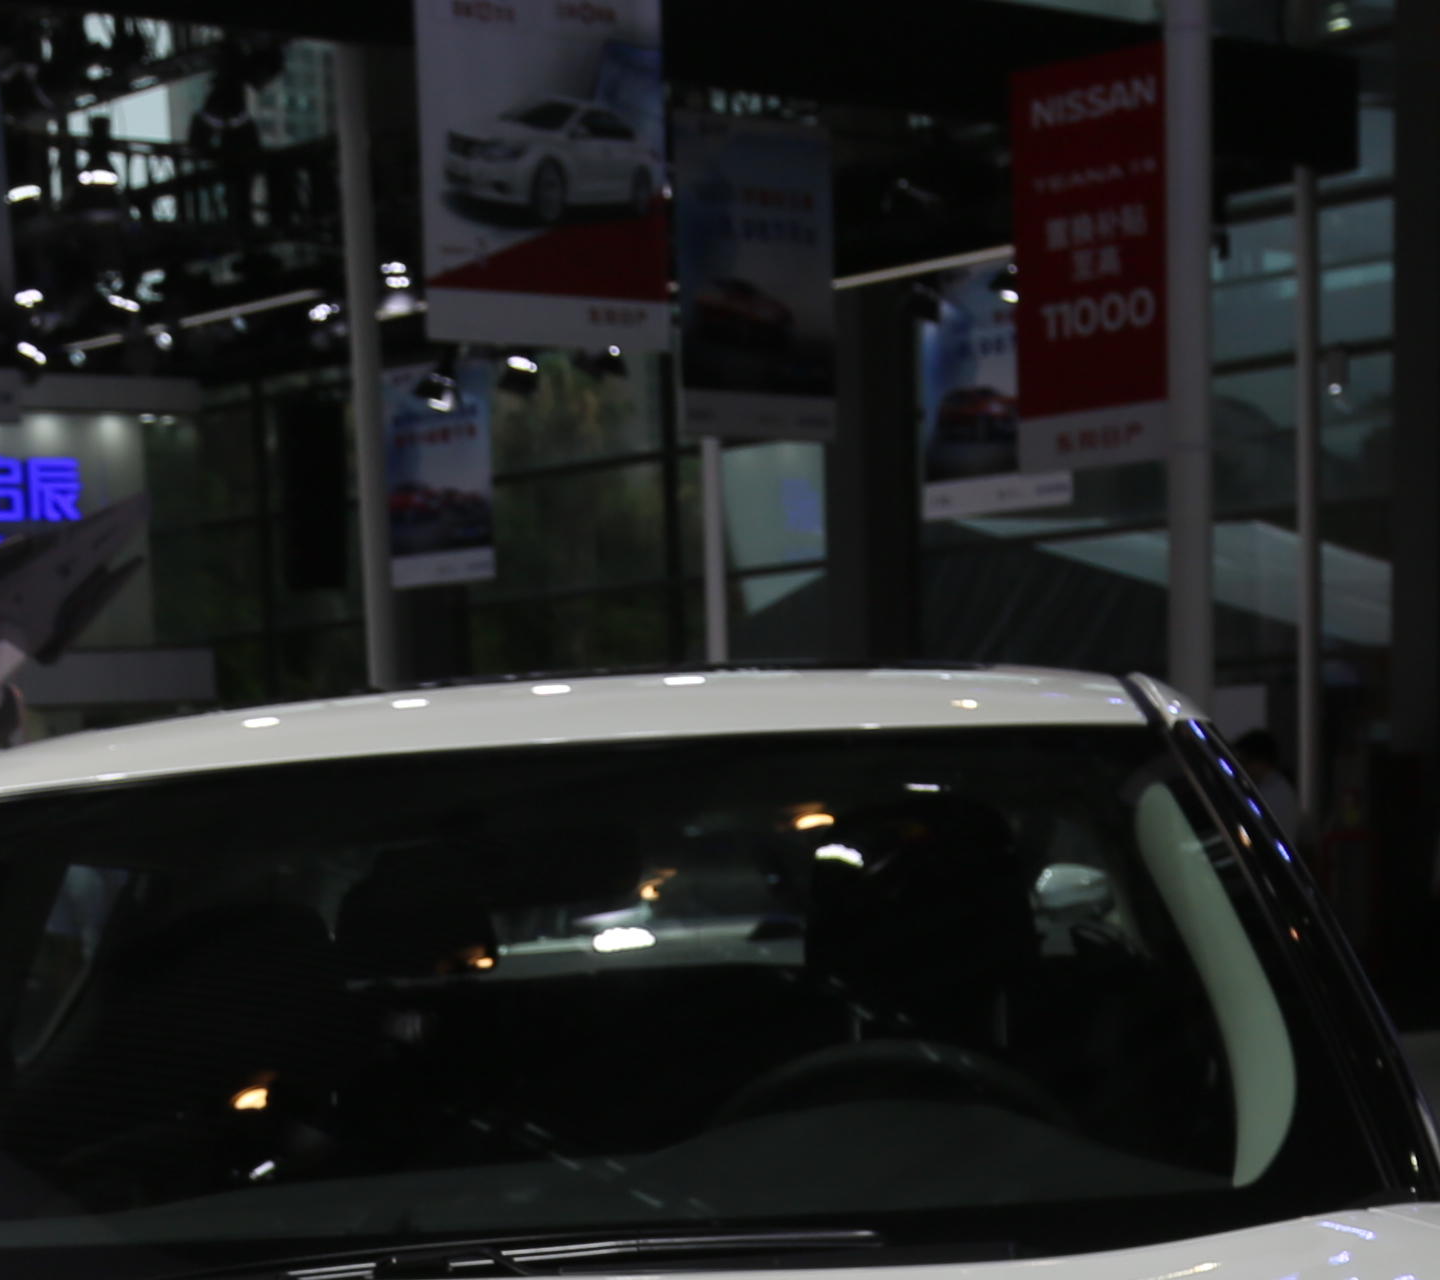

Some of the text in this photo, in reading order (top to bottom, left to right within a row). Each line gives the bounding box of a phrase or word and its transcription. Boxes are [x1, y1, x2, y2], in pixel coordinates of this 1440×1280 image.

[1028, 74, 1158, 131] NISSAN
[1070, 244, 1123, 283] 至高
[1040, 286, 1158, 345] 11000
